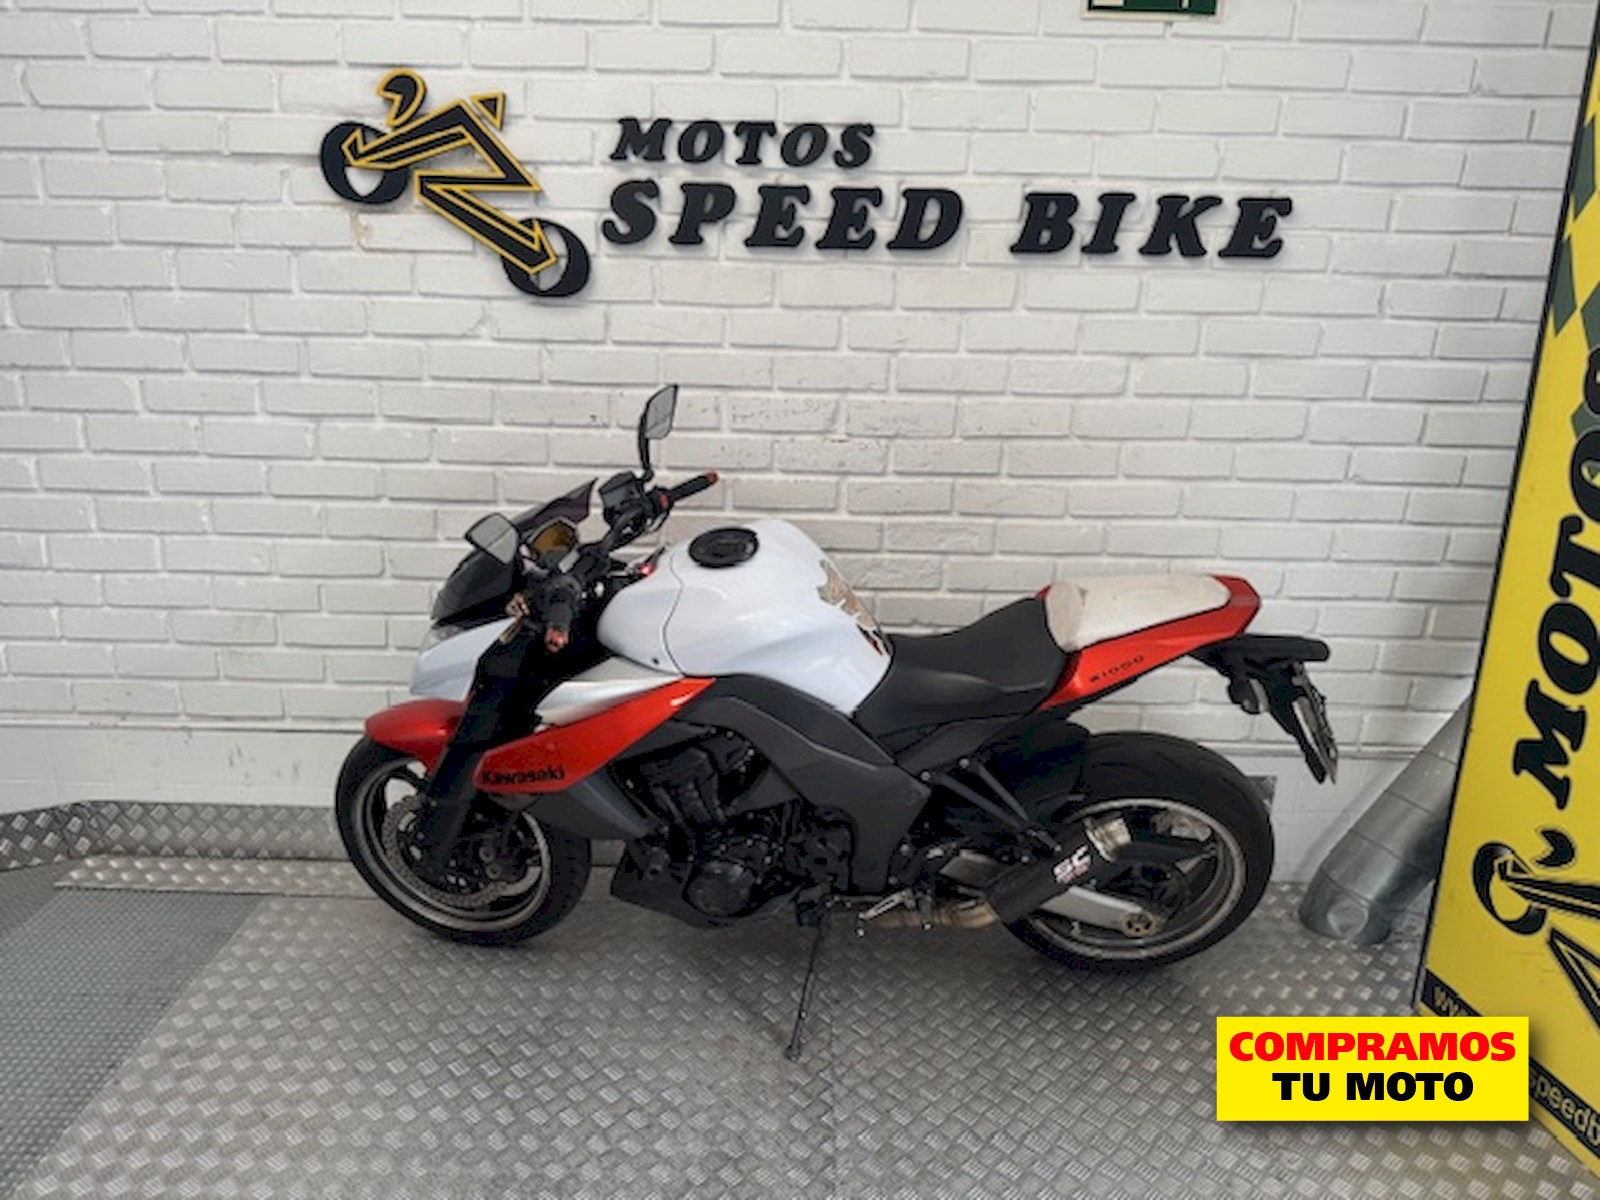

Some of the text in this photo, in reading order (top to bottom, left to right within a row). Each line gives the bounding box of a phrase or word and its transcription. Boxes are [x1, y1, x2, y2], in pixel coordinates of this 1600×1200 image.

[609, 117, 875, 168] MOTOS
[602, 179, 1293, 258] SPEED BIKE
[1512, 347, 1600, 811] MOTO
[480, 764, 566, 786] Kawasaki
